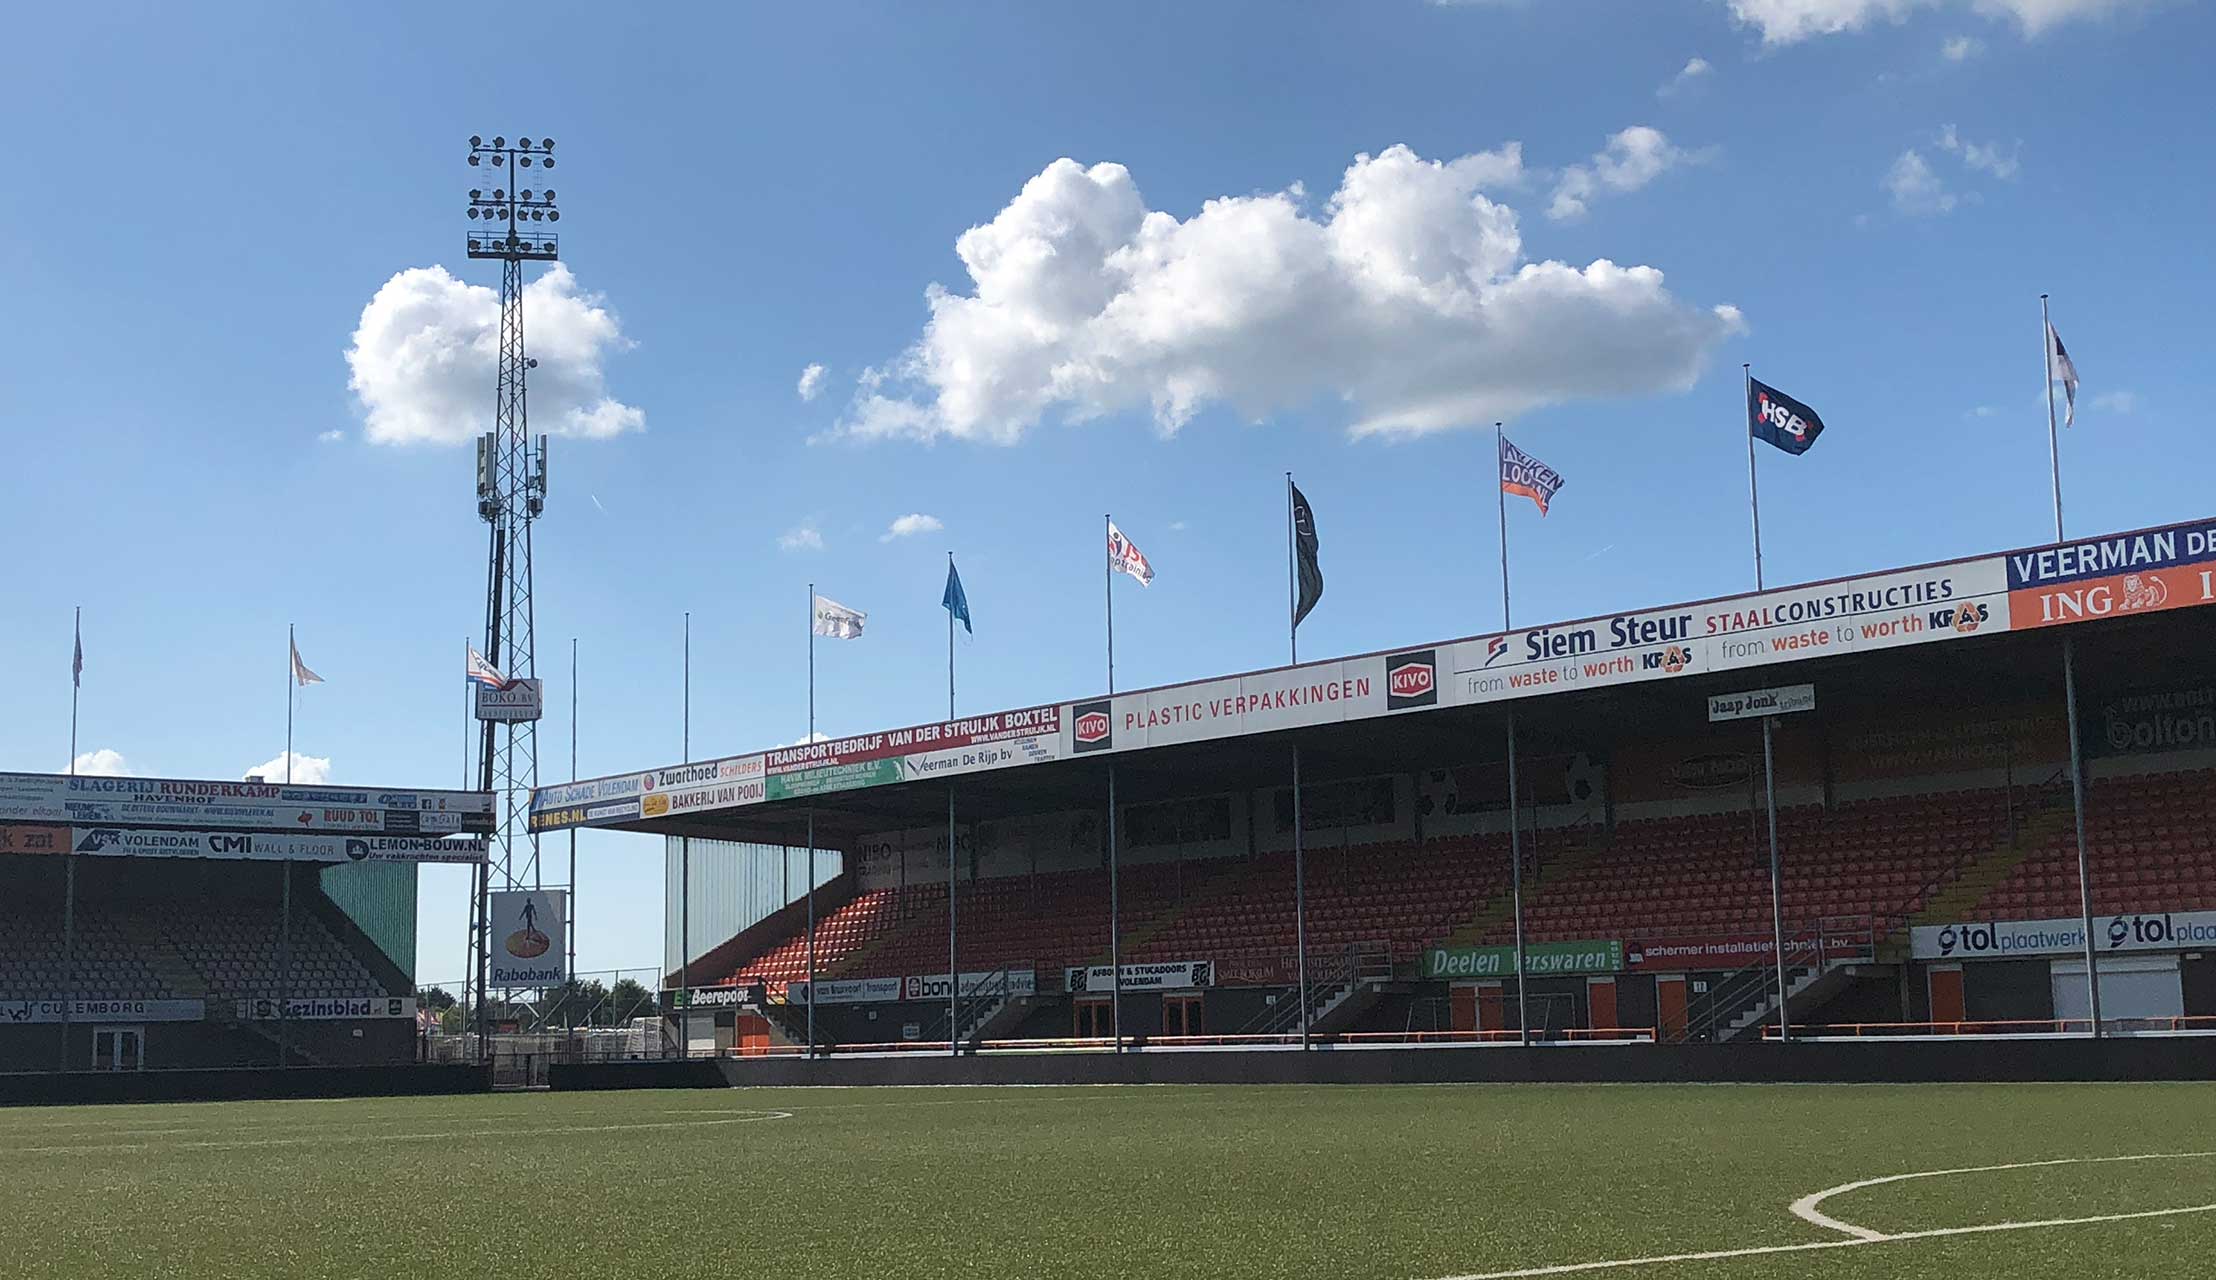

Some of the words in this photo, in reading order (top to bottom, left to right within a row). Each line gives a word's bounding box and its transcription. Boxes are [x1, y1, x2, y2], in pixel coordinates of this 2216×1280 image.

[1762, 400, 1807, 435] HSB
[2013, 531, 2176, 583] VEERMAN
[1707, 579, 1952, 634] STAALCONSTRUCTIES
[2040, 586, 2113, 622] ING
[1527, 630, 1595, 661] Siem
[1611, 614, 1692, 648] Steur
[1723, 641, 1765, 659] from
[1772, 630, 1829, 652] waste
[1836, 625, 1854, 642] to
[1861, 614, 1923, 639] worth
[1930, 604, 1989, 632] KRAS
[1393, 672, 1429, 689] KIVO
[1469, 676, 1504, 694] from
[1510, 667, 1557, 688] waste
[1564, 666, 1577, 681] to
[1584, 656, 1634, 678] worth
[1643, 647, 1693, 671] KRAS
[482, 692, 516, 703] BOKO
[1126, 703, 1202, 731] PLASTIC
[1210, 677, 1370, 719] VERPAKKINGEN
[1078, 718, 1107, 734] KIVO
[767, 736, 883, 767] TRANSPORTBEDRIJF
[888, 730, 912, 747] VAN
[916, 727, 940, 744] DER
[944, 717, 999, 739] STRUIJK
[1005, 708, 1057, 729] BOXTEL
[907, 754, 958, 776] Veerman
[963, 755, 975, 767] De
[979, 750, 998, 768] Rijp
[1002, 749, 1014, 760] bv
[659, 763, 718, 787] Zwarthoed
[720, 761, 762, 778] SCHILDERS
[69, 779, 154, 794] SLAGERIJ
[160, 783, 281, 799] RUNDERKAMP
[598, 778, 639, 798] VOLENDAM
[672, 790, 714, 810] BAKKERIJ
[717, 787, 735, 803] VAN
[134, 794, 217, 804] HAVENHOF
[324, 811, 355, 823] RUUD
[360, 812, 380, 824] TOL
[125, 835, 199, 848] VOLENDAM
[208, 836, 252, 854] CMI
[255, 843, 282, 854] WALL
[289, 843, 295, 855] &
[300, 844, 334, 856] FLOOR
[370, 838, 486, 852] LEMON-BOUW.NL
[1962, 922, 1997, 950] tol
[2001, 930, 2086, 955] plaatwerk
[2132, 912, 2172, 944] tol
[1646, 943, 1702, 958] schermer
[1136, 964, 1187, 976] STUCADOORS
[1434, 950, 1500, 975] Deelen
[494, 966, 561, 982] Rabobank
[1120, 976, 1162, 986] VOLENDAM
[692, 988, 749, 1006] Beerepoot
